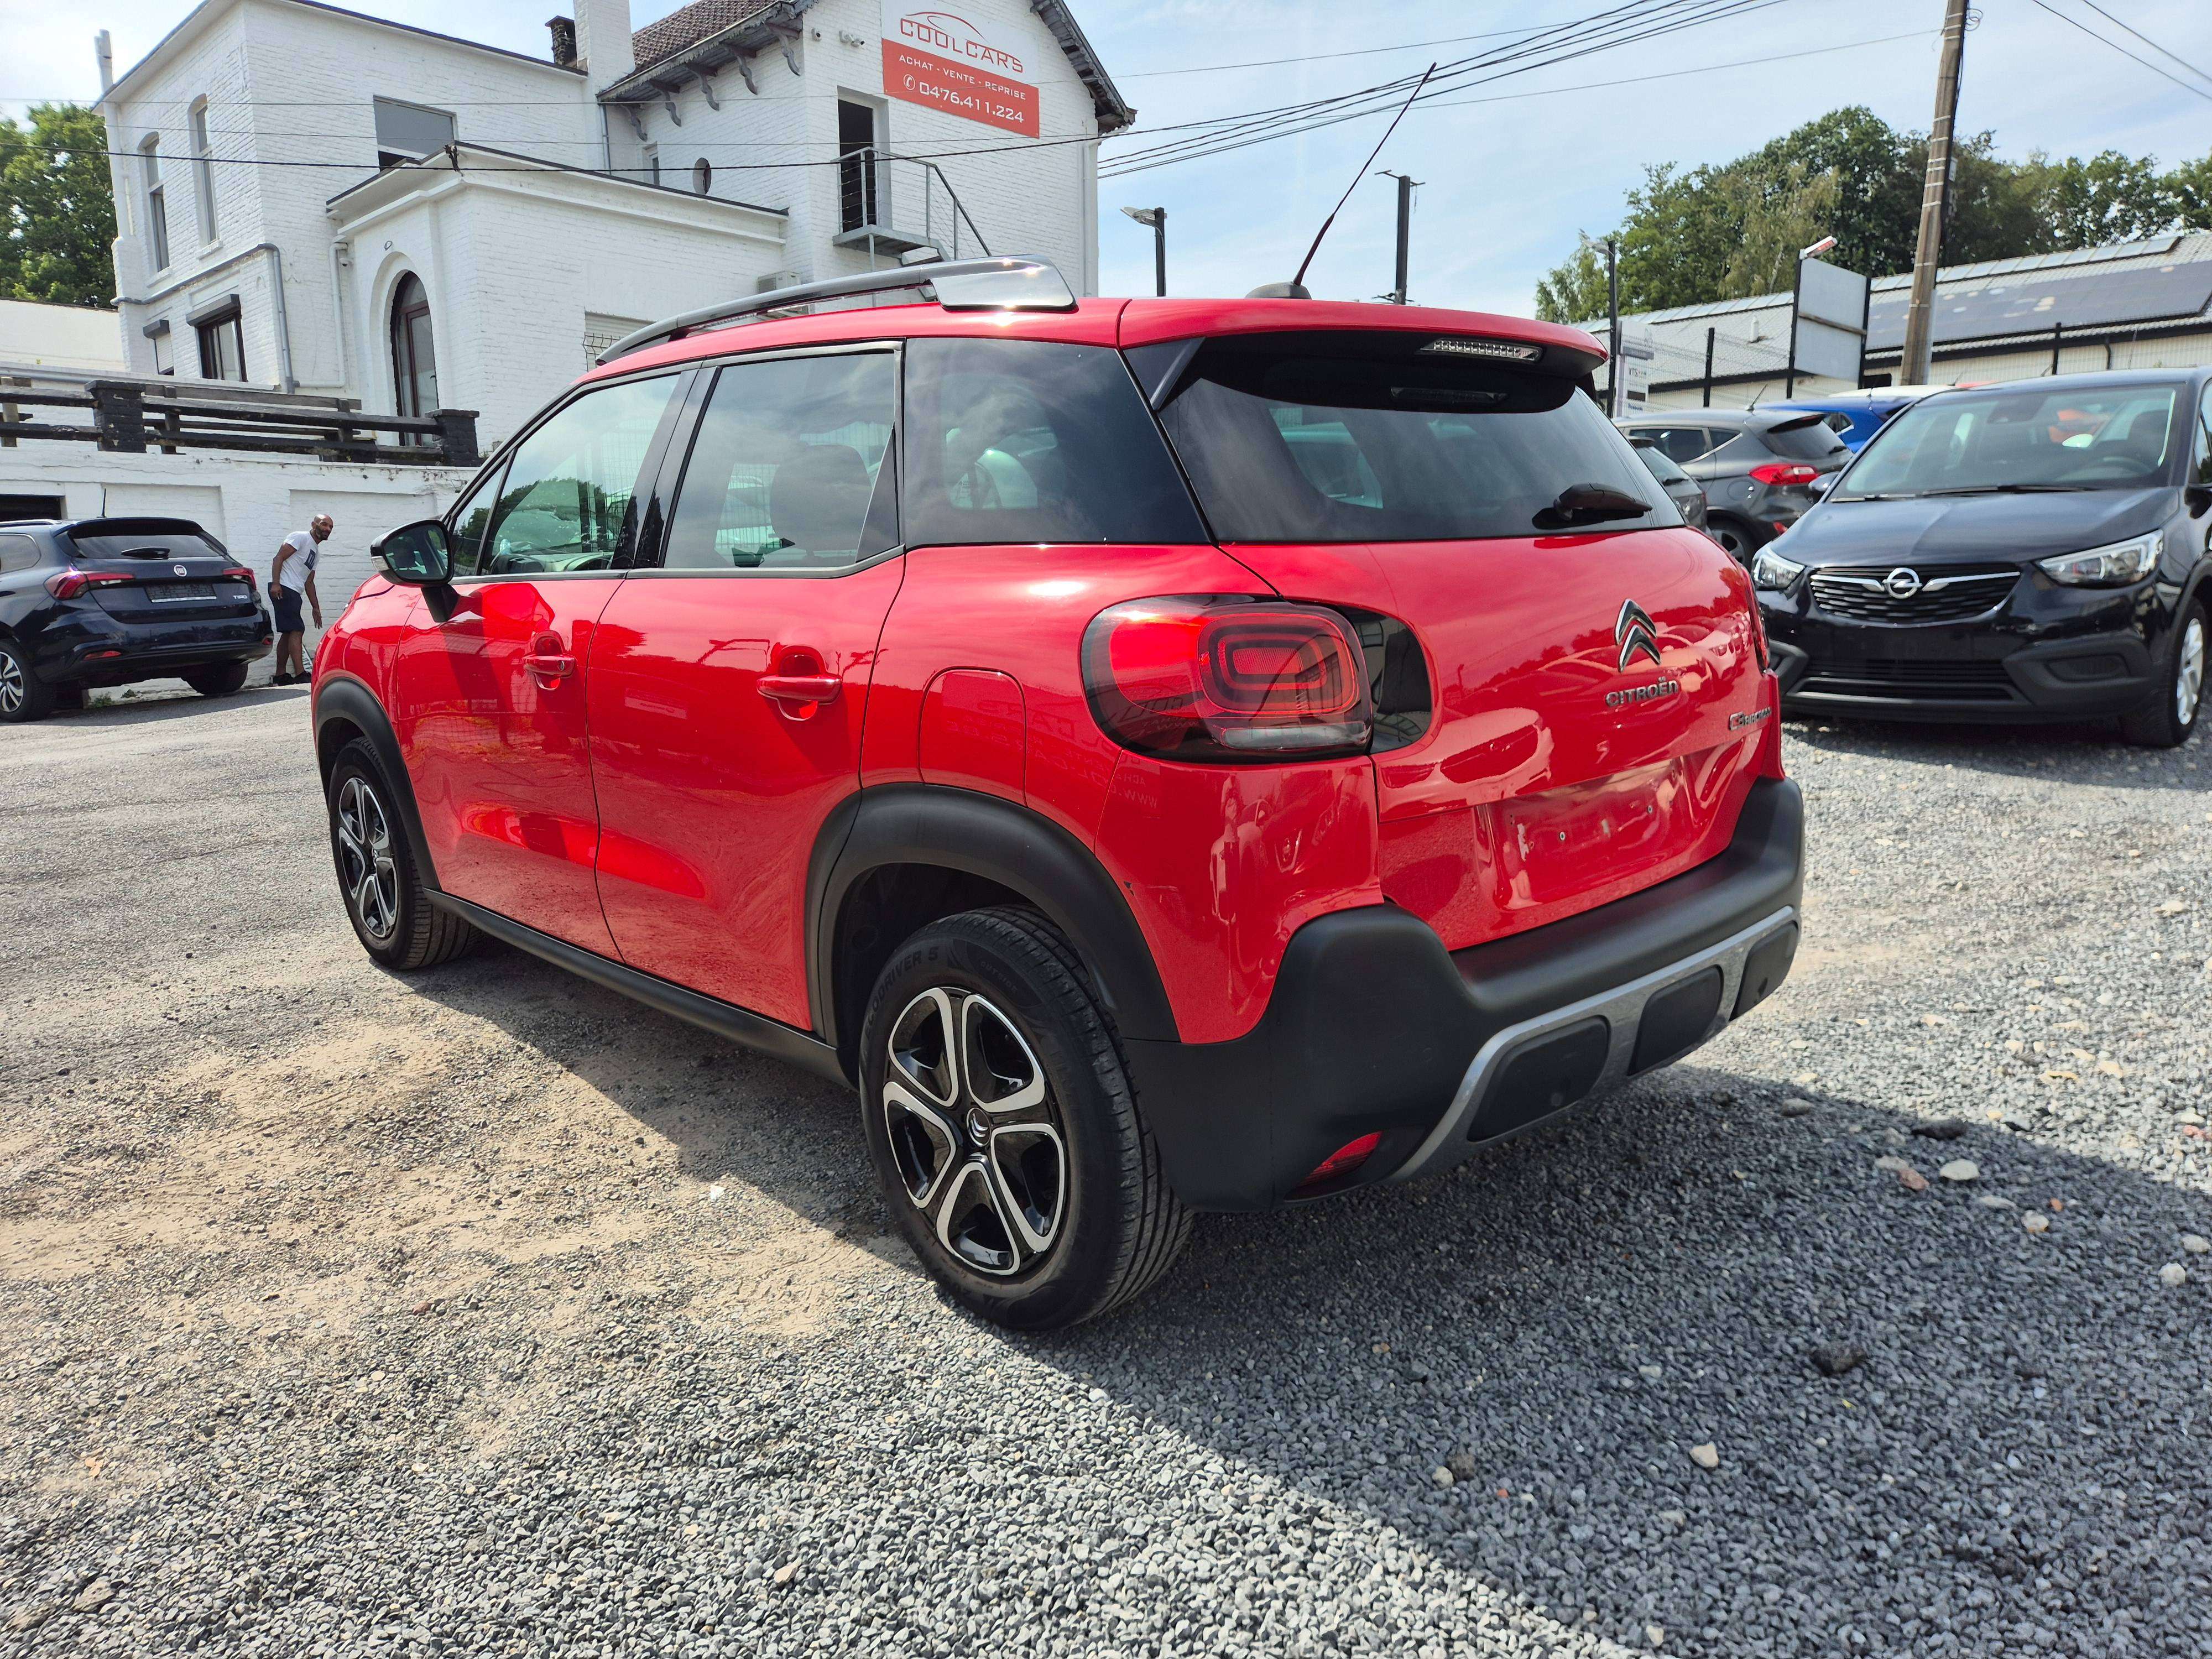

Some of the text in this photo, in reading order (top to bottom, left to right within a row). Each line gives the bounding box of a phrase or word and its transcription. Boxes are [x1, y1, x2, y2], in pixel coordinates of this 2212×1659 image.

[899, 54, 933, 71] ACHAT
[943, 67, 975, 85] VENTE
[985, 81, 1026, 100] REPRISE
[919, 81, 1024, 123] 0476.411.224
[1605, 676, 1679, 707] CITROËN
